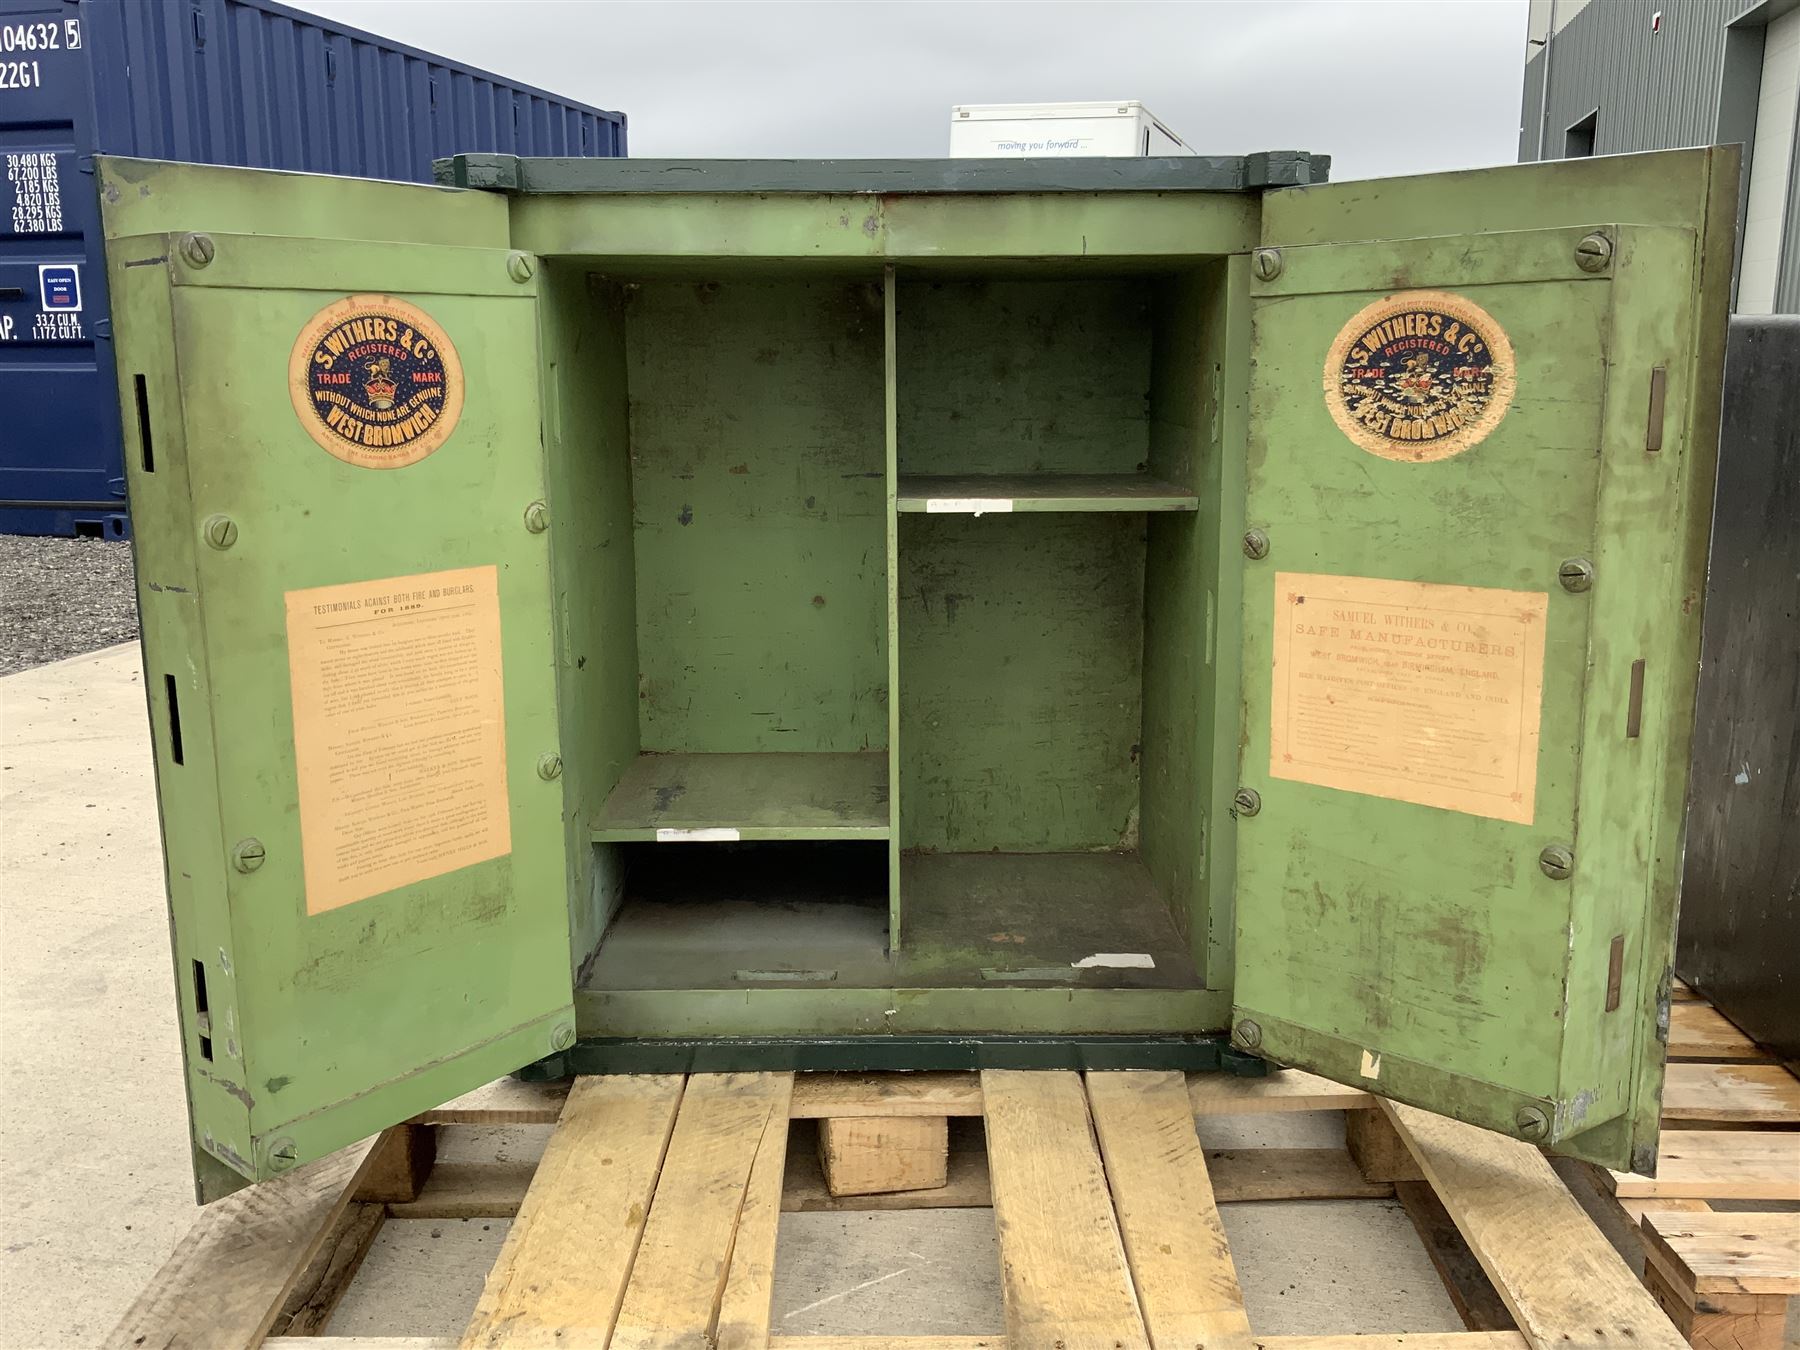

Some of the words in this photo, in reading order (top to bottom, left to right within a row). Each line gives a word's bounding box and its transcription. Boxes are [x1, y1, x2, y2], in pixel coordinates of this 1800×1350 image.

[0, 23, 59, 52] 04632
[67, 21, 78, 48] 5
[0, 61, 40, 88] 22G1
[998, 142, 1026, 151] moving
[1029, 142, 1043, 151] you
[1046, 139, 1079, 151] forward
[7, 154, 38, 168] 30.480
[40, 153, 57, 166] KGS
[8, 167, 39, 180] 67.200
[41, 166, 58, 179] LBS
[15, 180, 40, 193] 2.185
[42, 179, 59, 192] KGS
[17, 193, 42, 206] 4.820
[44, 192, 61, 205] LBS
[12, 206, 43, 220] 28.295
[45, 205, 62, 218] KGS
[14, 219, 45, 233] 62.380
[46, 218, 63, 232] LBS
[36, 313, 55, 327] 33.2
[57, 313, 81, 326] CU.M.
[32, 326, 57, 340] 1.172
[59, 326, 86, 339] CU.FT.
[323, 318, 398, 357] WITHERS
[400, 328, 413, 351] &
[1362, 312, 1442, 353] WITHERS
[1444, 322, 1459, 346] &
[348, 343, 407, 362] REGISTERED
[1384, 338, 1450, 358] REGISTERED
[316, 373, 351, 384] TRADE
[412, 372, 442, 383] MARK
[1351, 368, 1386, 378] TRADE
[315, 390, 351, 408] WITHOUT
[350, 402, 376, 421] WHICH
[376, 410, 397, 422] NONE
[396, 403, 410, 418] ARE
[409, 387, 442, 408] GENUINE
[326, 404, 363, 442] WEST
[313, 599, 361, 616] TESTIMONIALS
[364, 595, 390, 608] AGAINST
[393, 592, 411, 604] BOTH
[412, 590, 426, 601] FIRE
[428, 588, 441, 599] AND
[374, 606, 394, 615] FOR
[1332, 609, 1377, 625] SAMUEL
[1384, 614, 1435, 630] WITHERS
[1440, 622, 1449, 632] &
[1295, 623, 1340, 638] SAFE
